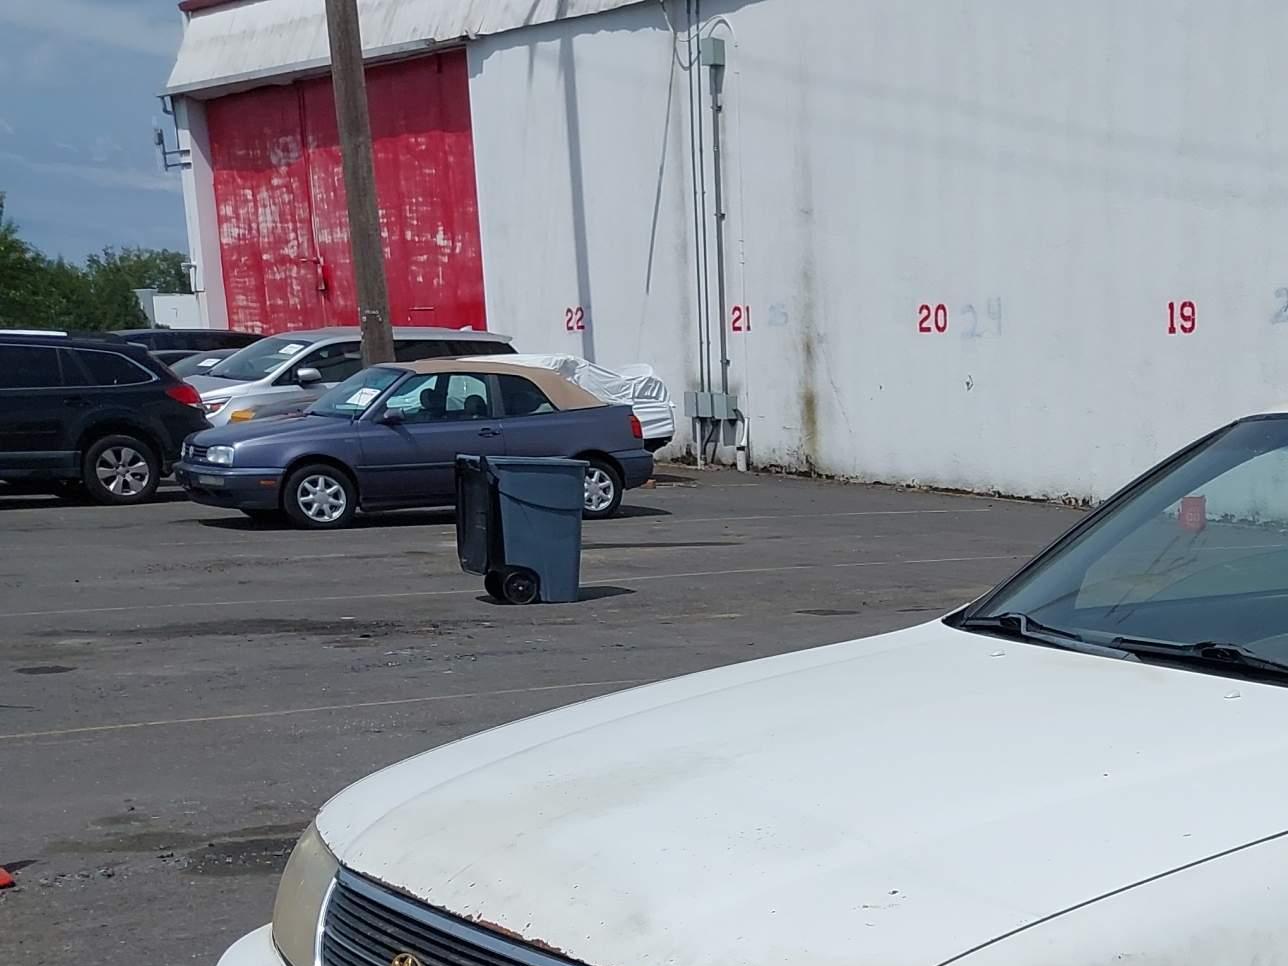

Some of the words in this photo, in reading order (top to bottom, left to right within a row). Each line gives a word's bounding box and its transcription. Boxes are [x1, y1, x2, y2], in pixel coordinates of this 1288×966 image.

[566, 307, 585, 330] 22
[732, 306, 751, 331] 21
[919, 304, 947, 332] 20
[1168, 301, 1195, 334] 19
